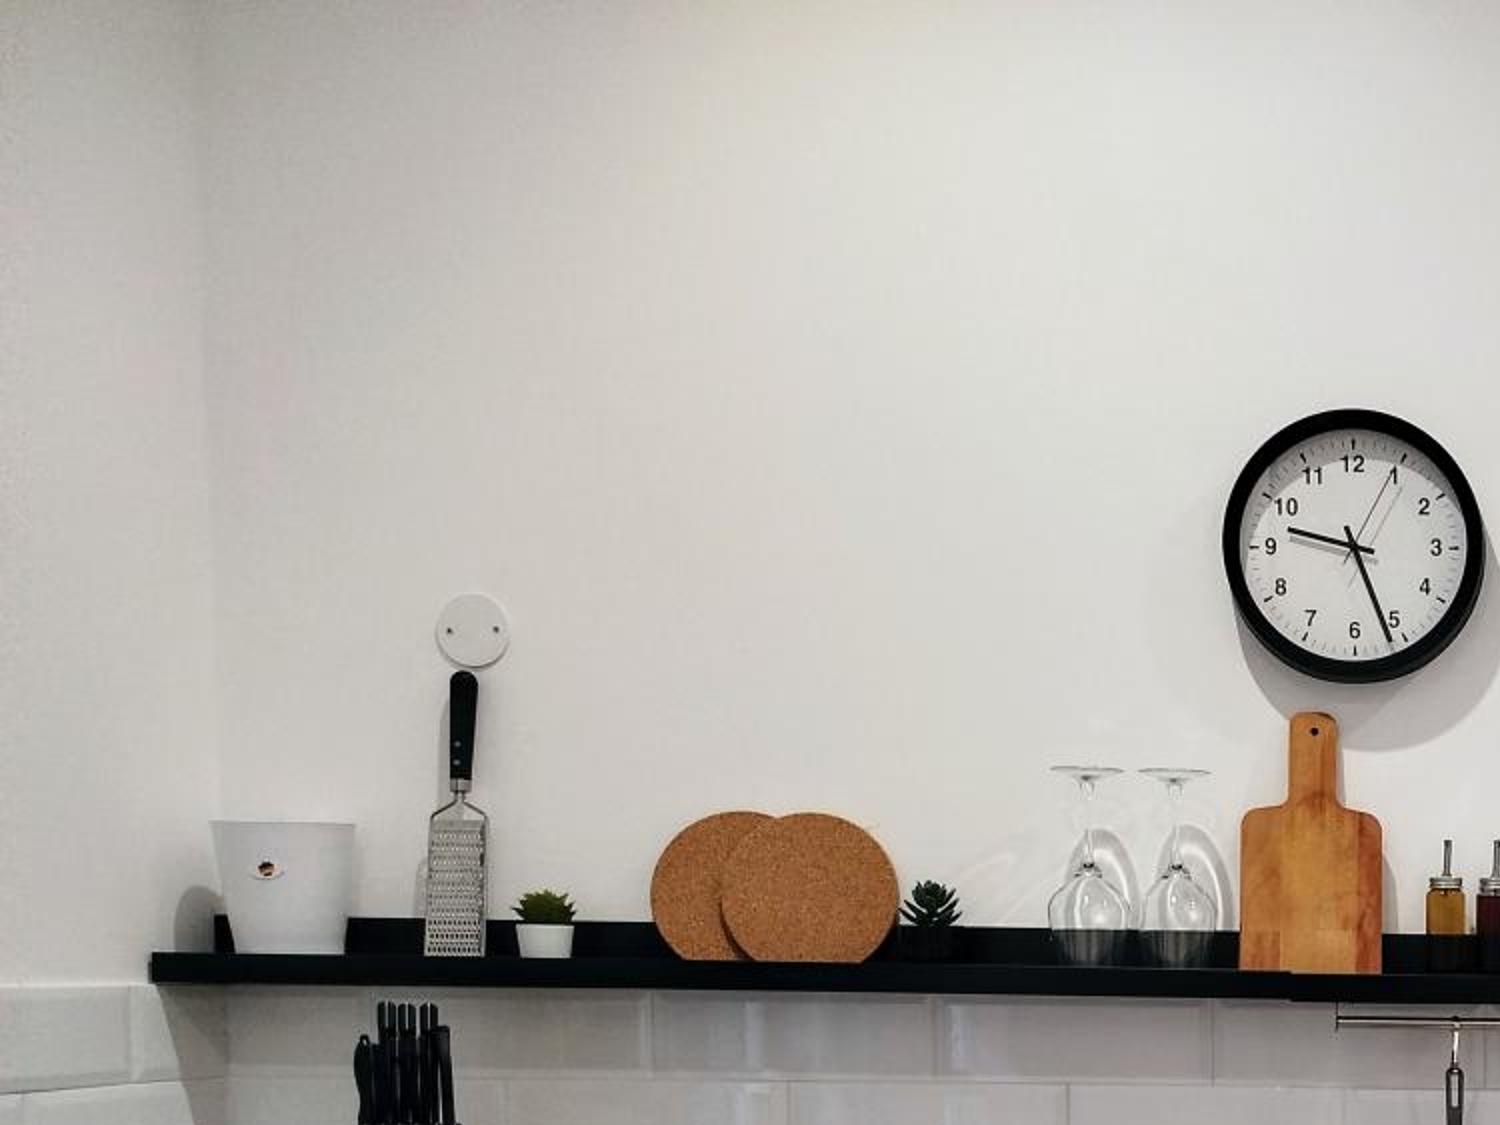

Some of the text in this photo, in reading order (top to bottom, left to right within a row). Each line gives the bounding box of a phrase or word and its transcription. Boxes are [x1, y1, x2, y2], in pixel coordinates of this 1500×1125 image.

[1341, 455, 1365, 473] 12
[1302, 467, 1323, 485] 11
[1275, 498, 1299, 516] 10
[1418, 498, 1431, 515] 2
[1265, 538, 1277, 555] 9
[1430, 539, 1442, 556] 3
[1275, 578, 1287, 596] 8
[1419, 578, 1431, 596] 4
[1305, 609, 1317, 627] 7
[1389, 610, 1400, 628] 5
[1349, 622, 1361, 639] 6
